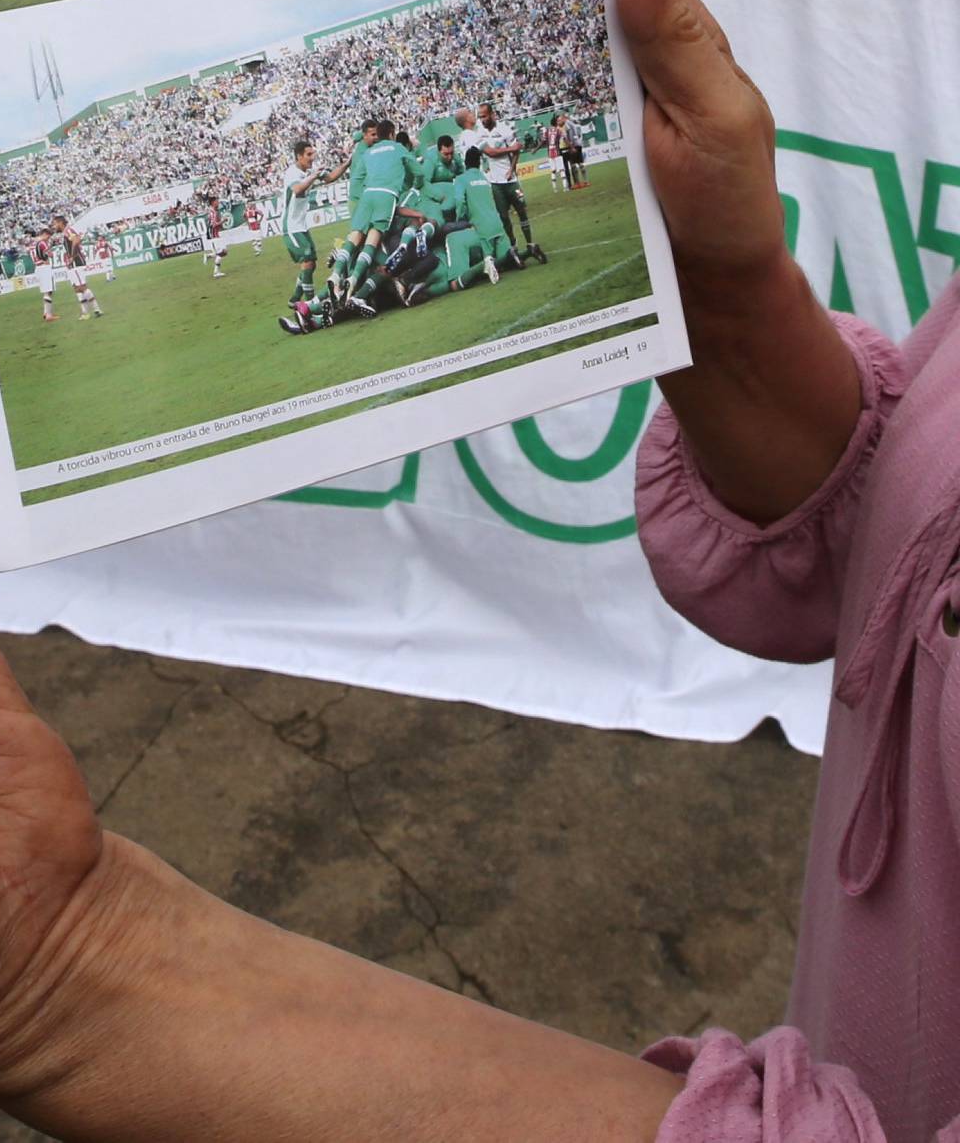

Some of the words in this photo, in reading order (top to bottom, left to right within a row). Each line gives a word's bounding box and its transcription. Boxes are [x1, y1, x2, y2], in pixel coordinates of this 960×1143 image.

[58, 463, 65, 473] A
[67, 455, 100, 471] torcida
[101, 448, 131, 461] vibrou
[133, 442, 154, 453] com
[199, 426, 210, 435] de
[214, 418, 240, 433] Bruno
[241, 407, 270, 427] Rangel
[271, 405, 286, 416] aos
[299, 389, 332, 408] minutos
[332, 388, 344, 397] do
[345, 378, 379, 394] segundo
